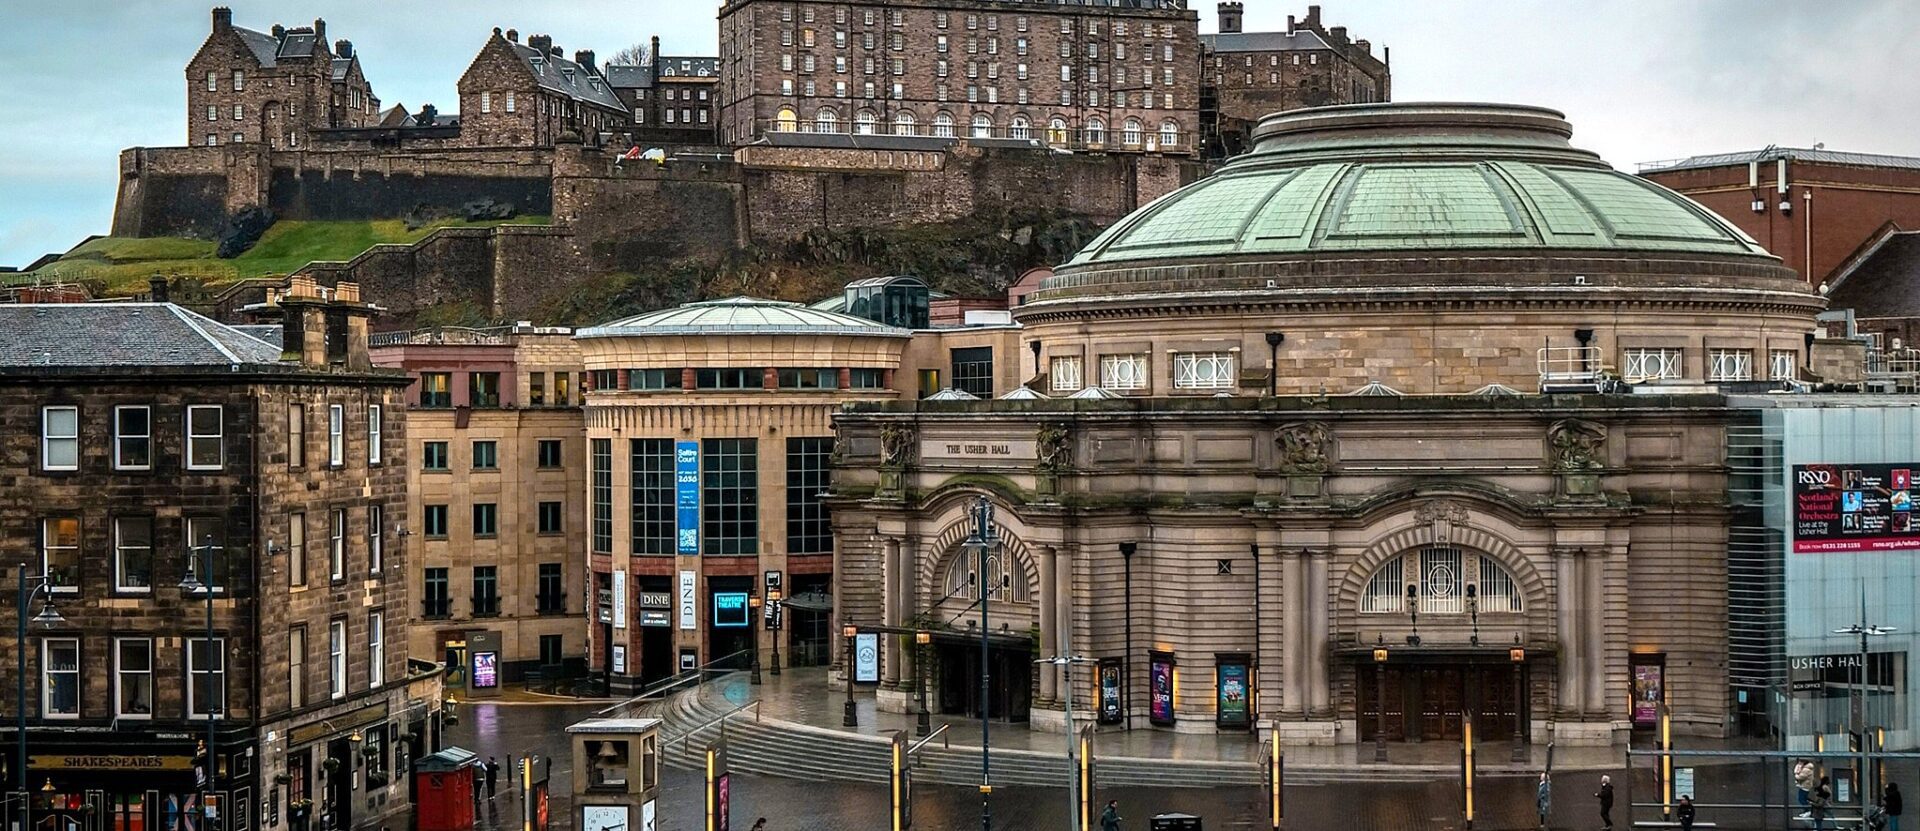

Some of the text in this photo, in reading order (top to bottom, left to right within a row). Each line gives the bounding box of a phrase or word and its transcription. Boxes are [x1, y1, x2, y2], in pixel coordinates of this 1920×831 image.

[946, 445, 1010, 454] THE USHER HALL
[1799, 471, 1830, 483] RSNO
[1799, 492, 1839, 500] Scotland's
[1799, 502, 1834, 511] National
[1799, 512, 1839, 520] Orchestra
[643, 595, 669, 605] DINE
[684, 578, 693, 616] DINE
[1792, 656, 1867, 669] USHER HAL
[64, 757, 163, 768] SHAKESPEARES
